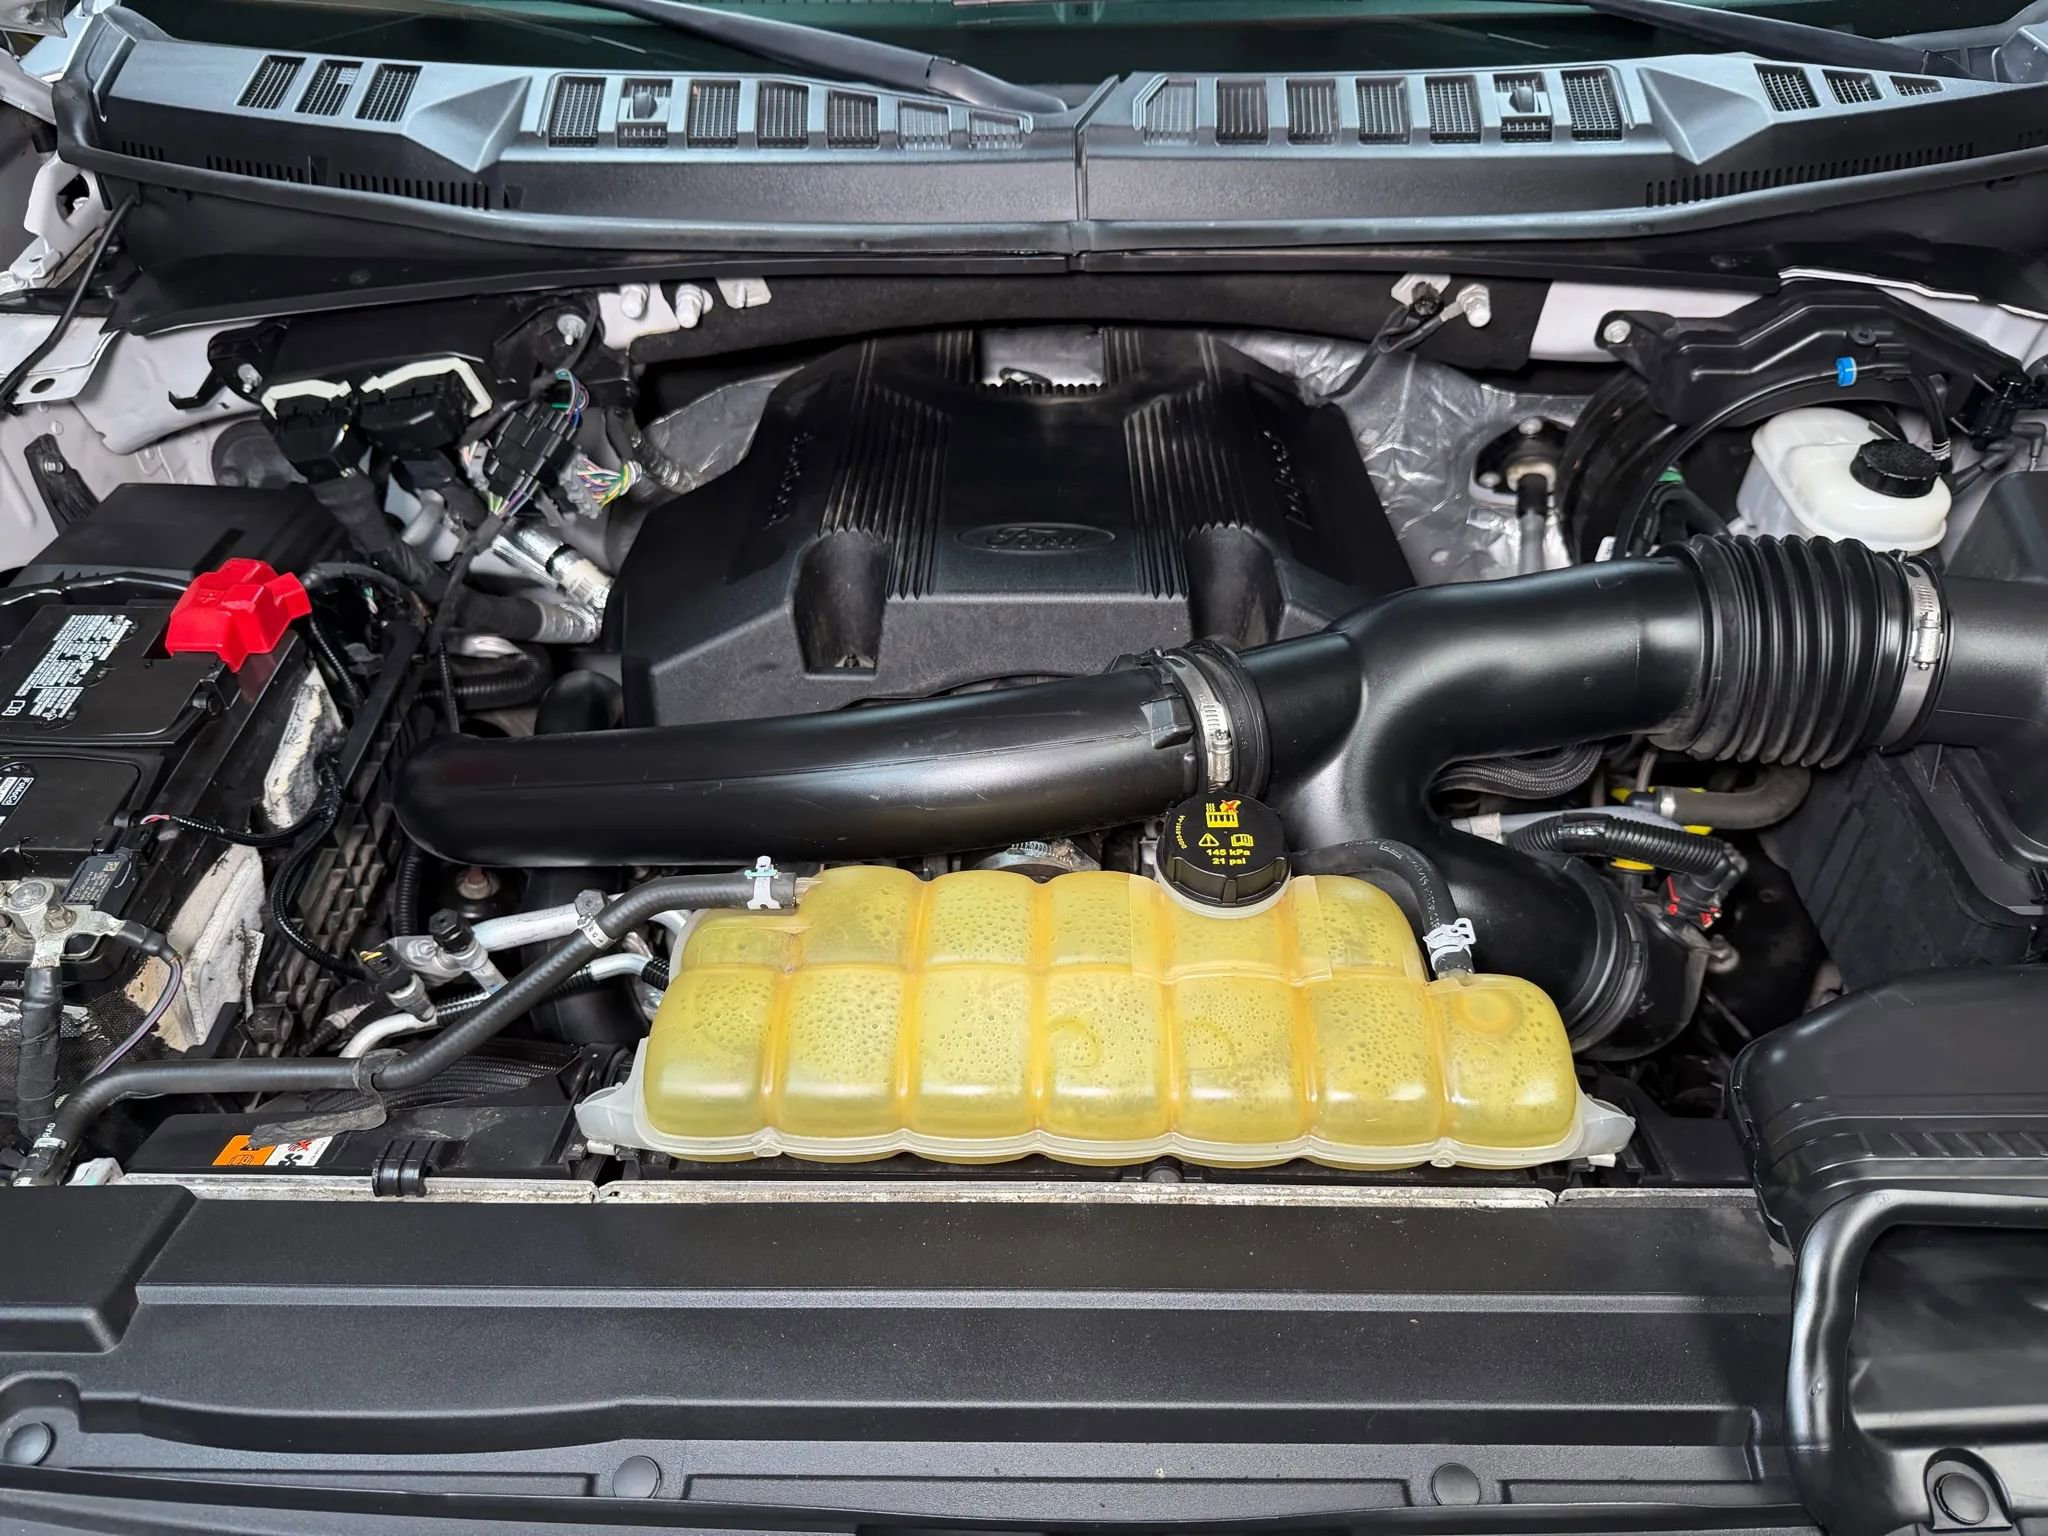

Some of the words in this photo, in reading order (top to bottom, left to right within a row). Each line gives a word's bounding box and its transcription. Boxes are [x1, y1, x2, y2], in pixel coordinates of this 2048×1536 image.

[983, 526, 1087, 549] Ford
[4, 777, 31, 804] FoMoCo
[1229, 858, 1246, 866] psi
